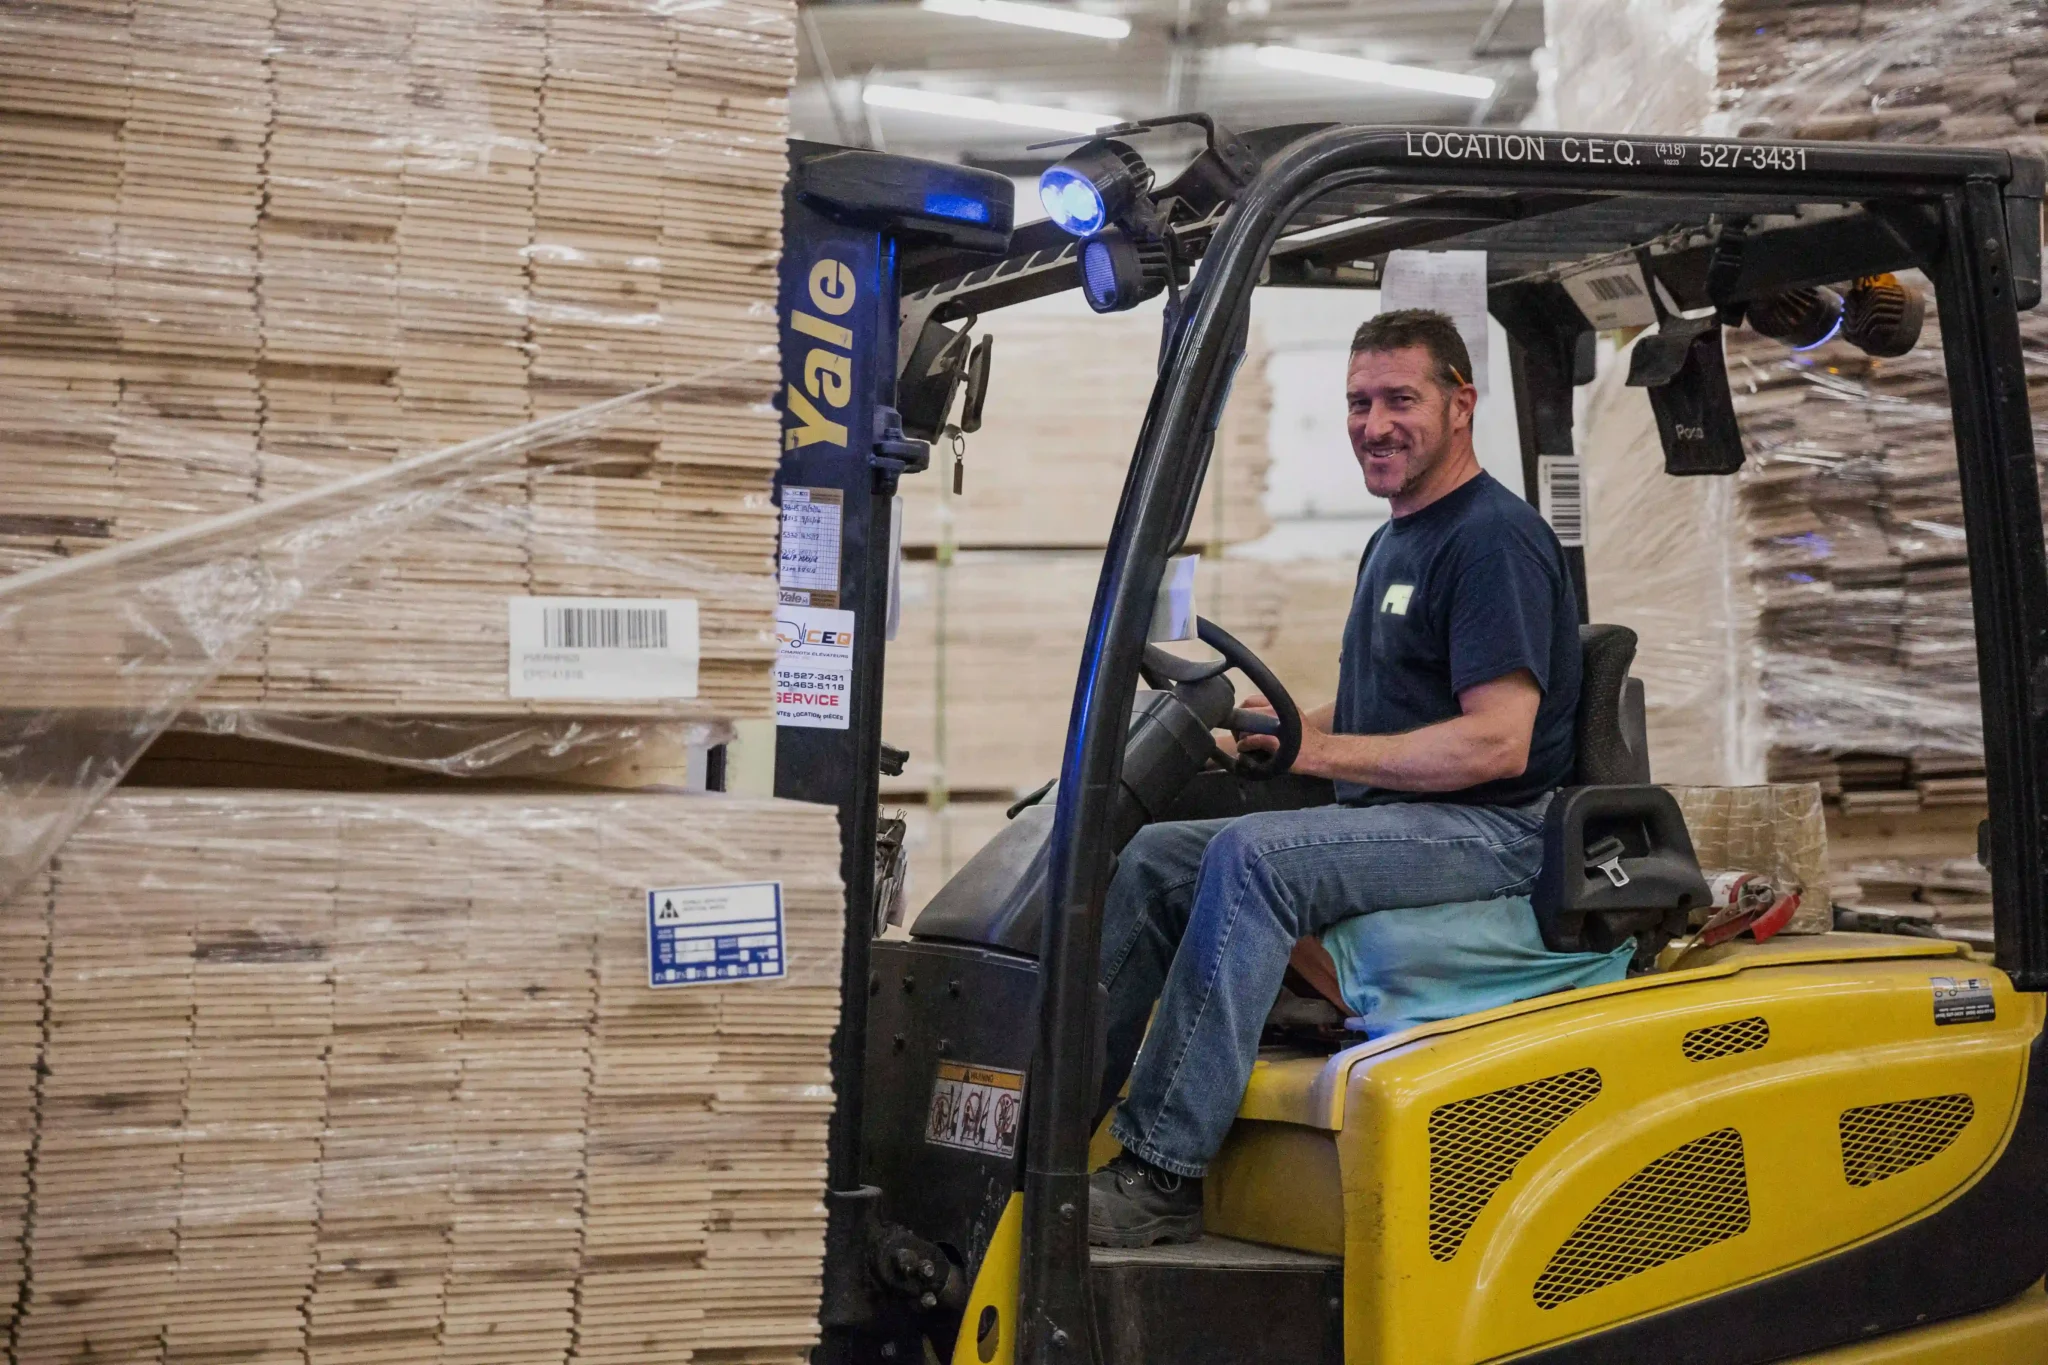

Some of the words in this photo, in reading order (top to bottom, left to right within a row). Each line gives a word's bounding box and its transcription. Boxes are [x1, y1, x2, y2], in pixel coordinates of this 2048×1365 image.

[1406, 131, 1545, 160] LOCATION
[1561, 137, 1641, 166] C.E.Q.
[1655, 142, 1686, 158] (418)
[1700, 143, 1806, 170] 527-3431
[785, 258, 856, 451] Yale
[780, 591, 802, 603] Yale
[807, 629, 852, 645] CEQ
[793, 711, 821, 719] LOCATION
